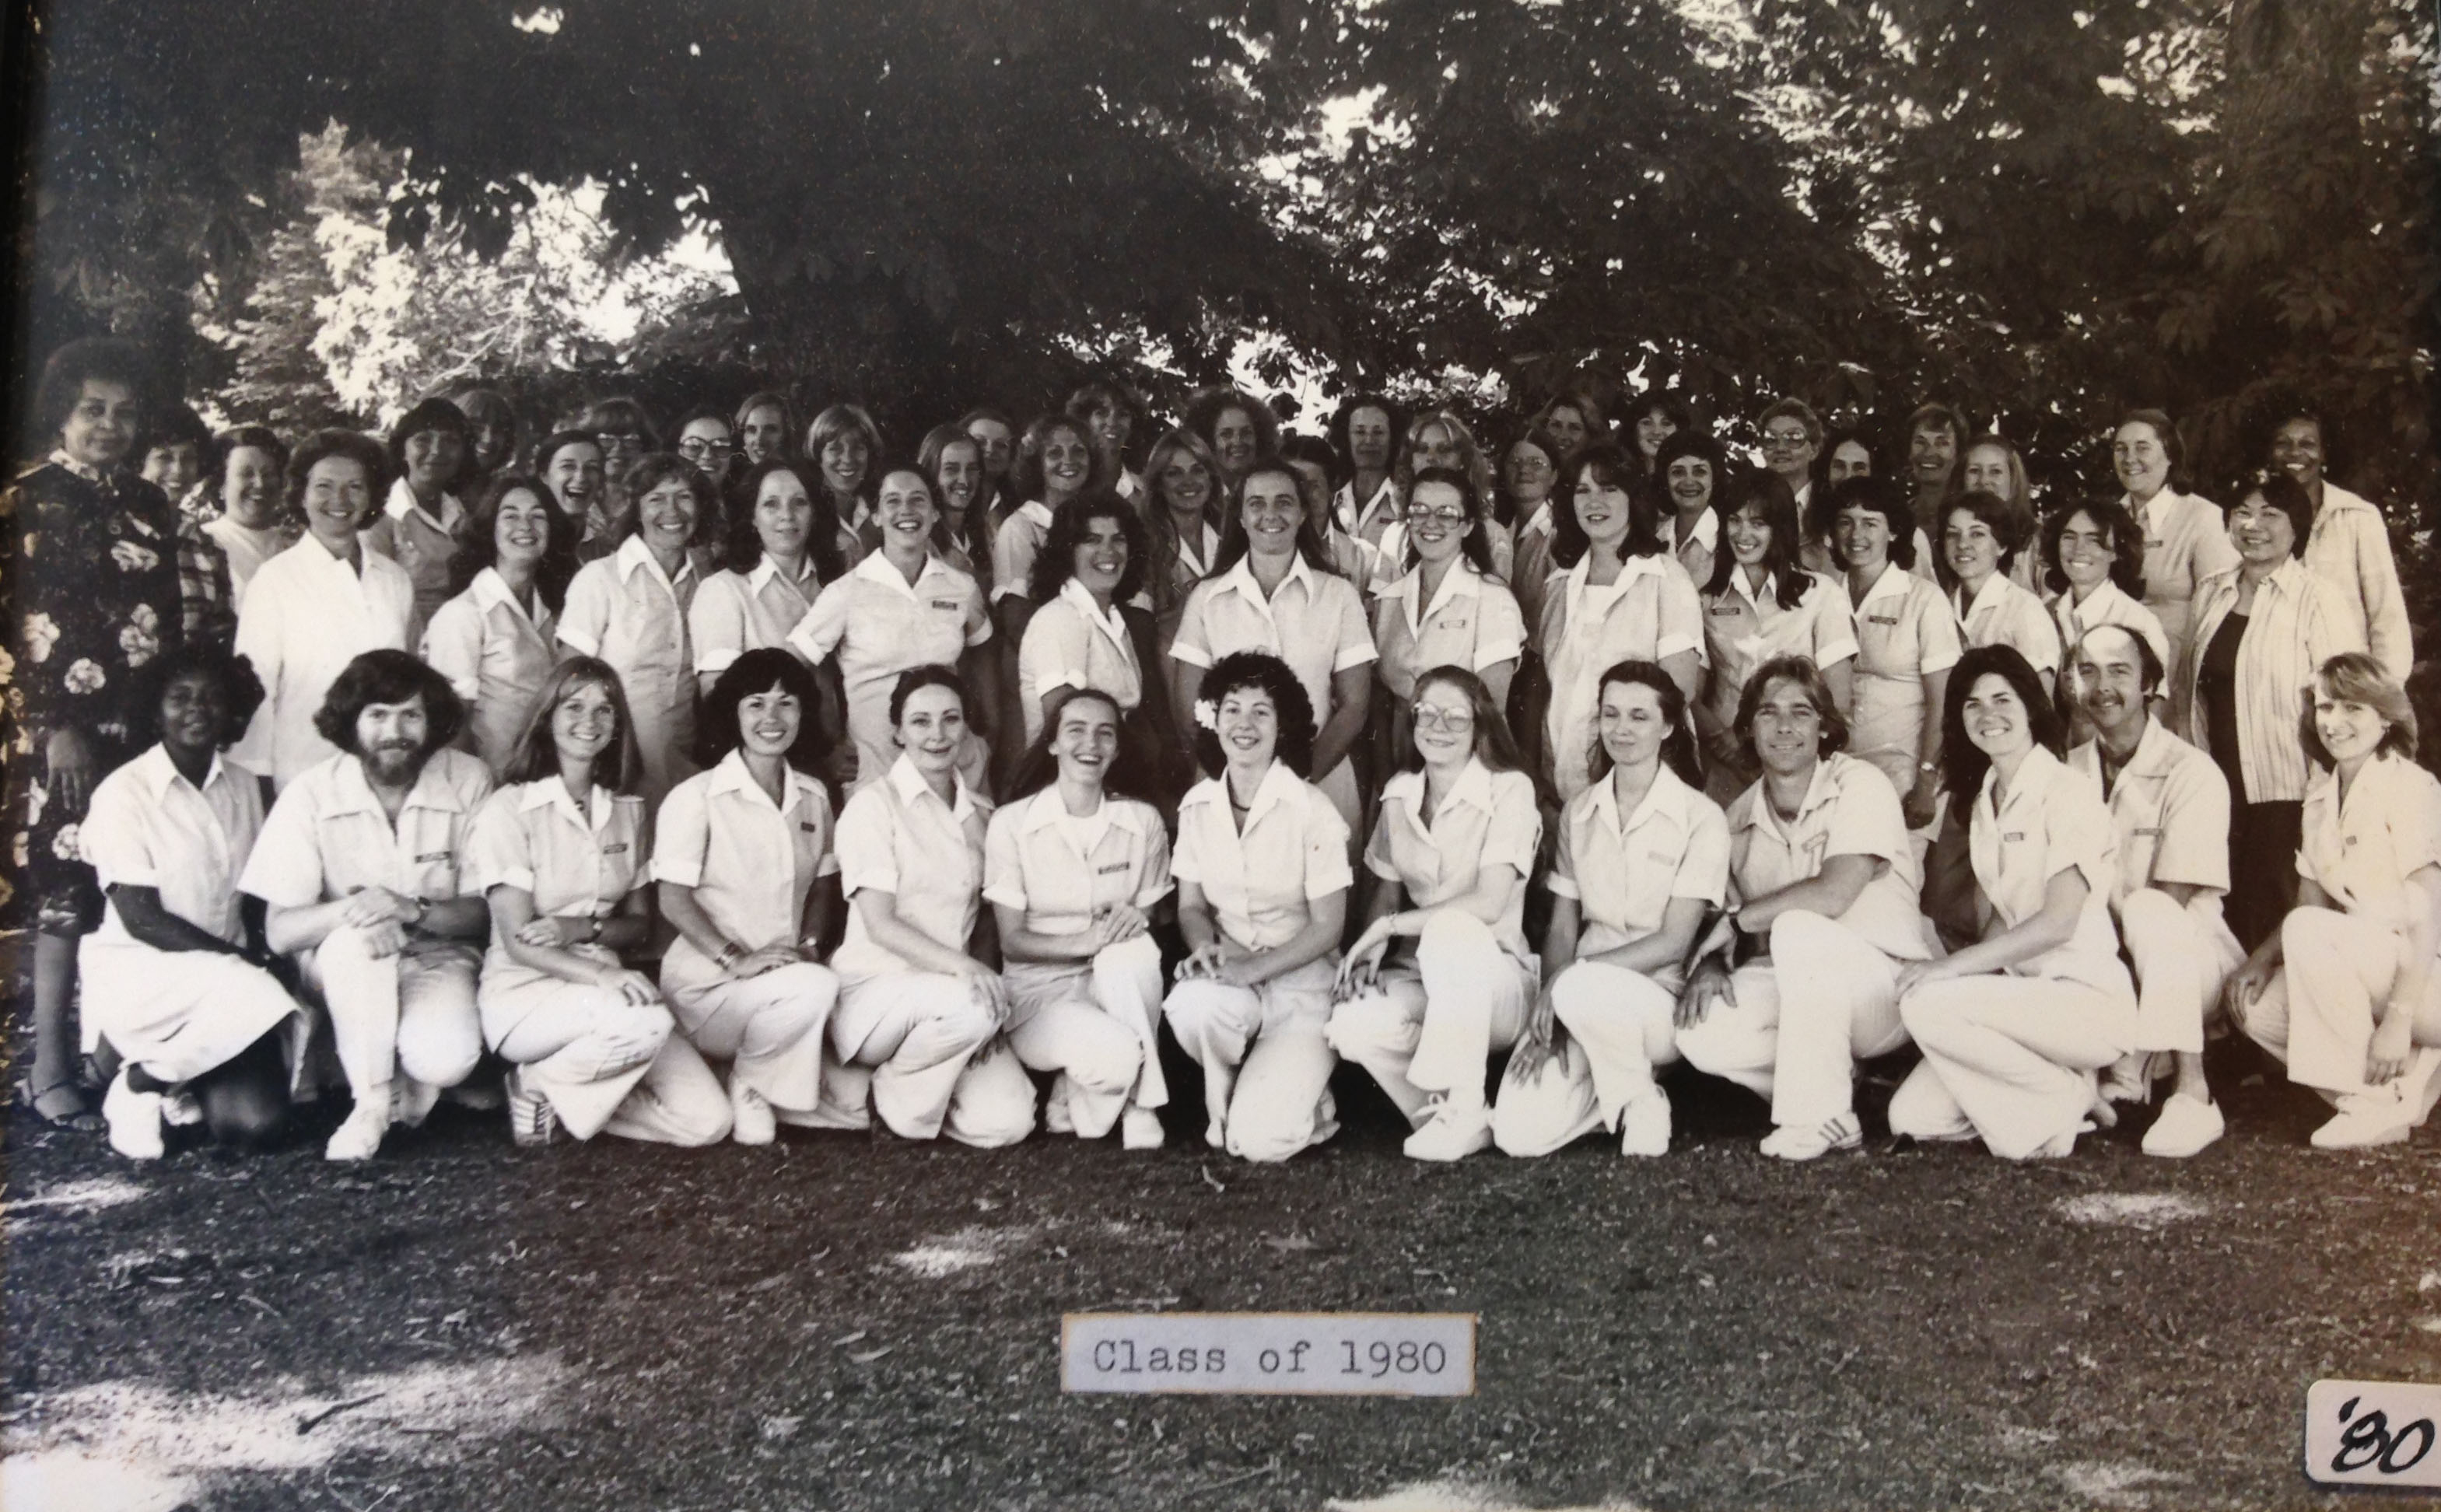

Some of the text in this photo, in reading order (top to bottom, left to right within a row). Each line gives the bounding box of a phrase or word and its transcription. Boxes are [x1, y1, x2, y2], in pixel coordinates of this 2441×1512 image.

[1093, 1339, 1447, 1378] Class of 1980
